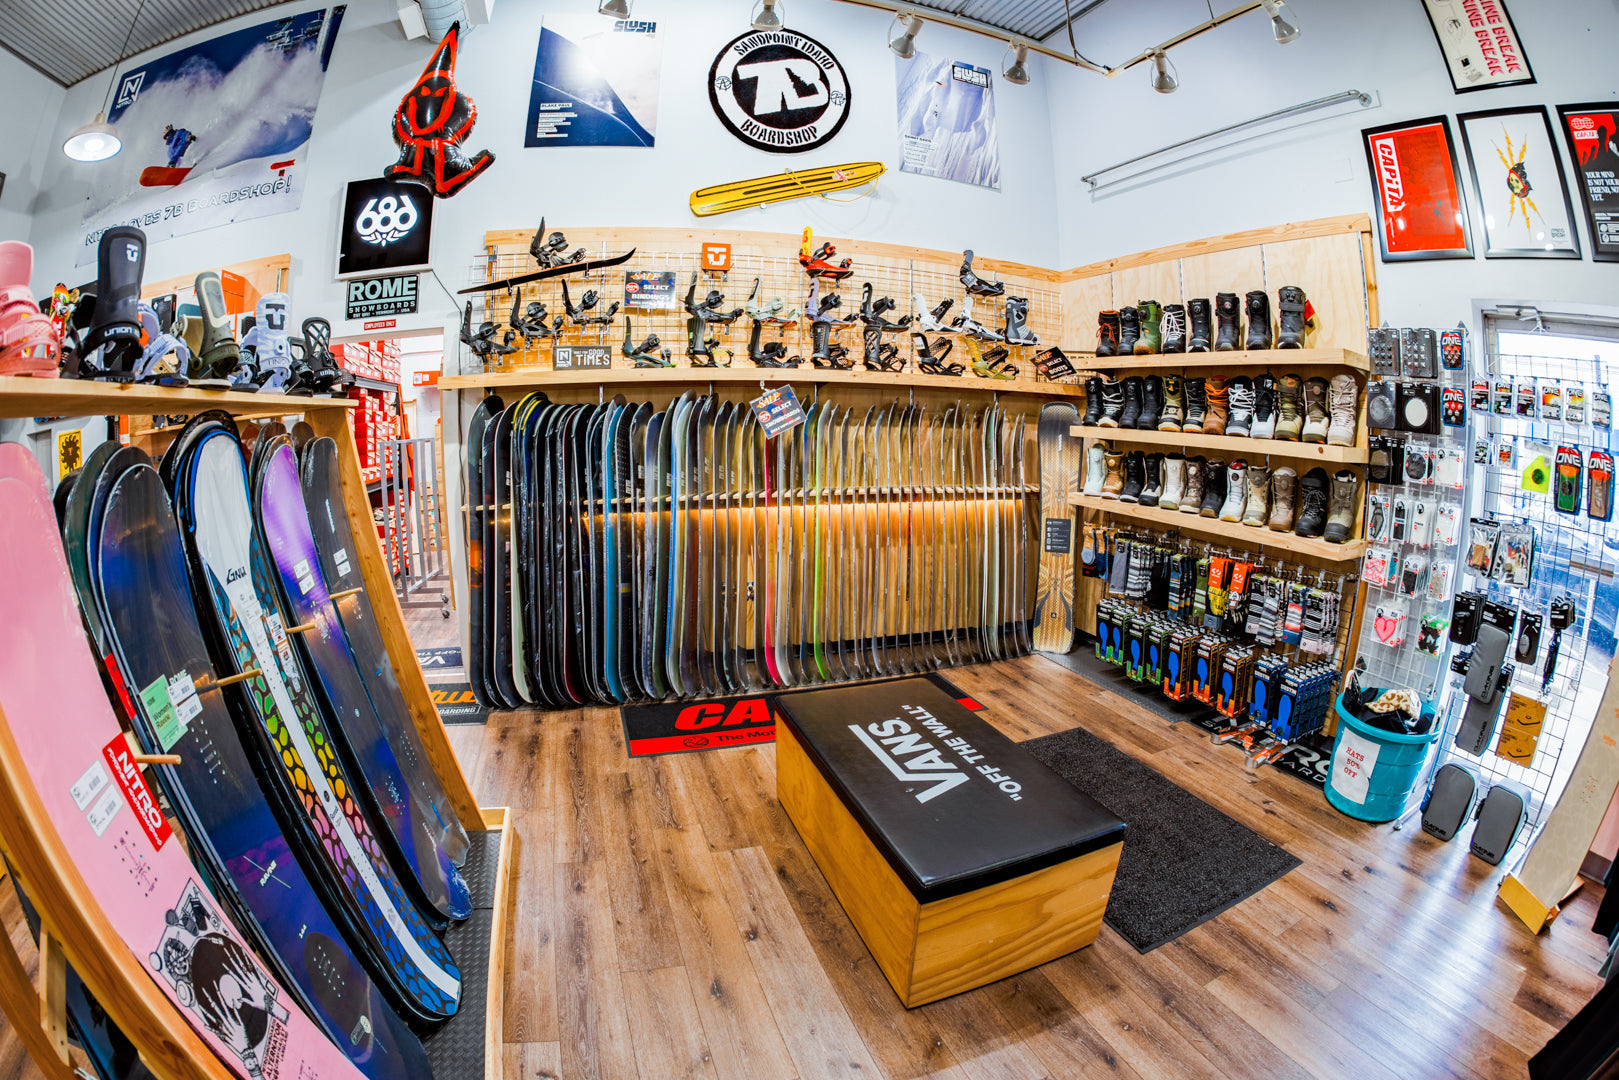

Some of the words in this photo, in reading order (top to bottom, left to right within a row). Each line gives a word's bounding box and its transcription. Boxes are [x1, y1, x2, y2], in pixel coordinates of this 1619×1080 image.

[614, 20, 656, 33] SLUSH
[1480, 0, 1502, 24] ING
[1492, 26, 1522, 73] BREAK
[733, 32, 802, 56] SANDPOINT
[801, 41, 835, 70] IDAHO
[1475, 29, 1504, 76] BREAK
[953, 66, 987, 86] SLUSH
[740, 119, 818, 146] BOARDSHOP
[187, 175, 292, 214] BOARDSHOP!
[356, 195, 418, 235] 686
[633, 272, 661, 280] SALE
[350, 276, 417, 302] ROME
[349, 301, 415, 314] SNOWBOARDS
[104, 326, 132, 337] union
[364, 321, 385, 329] EMPLOYEES
[1442, 336, 1462, 346] ONE
[576, 354, 610, 366] TIMES
[1047, 357, 1063, 367] SELECT
[1049, 364, 1069, 375] BOOTS
[1443, 393, 1465, 403] ONE
[1543, 387, 1560, 395] ONE
[1568, 389, 1583, 397] ONE
[1593, 394, 1608, 402] ONE
[771, 400, 792, 414] SELECT
[765, 408, 801, 429] SNOWBOARDS
[1556, 453, 1581, 468] ONE
[1588, 458, 1612, 473] ONE
[226, 566, 247, 585] GNU
[1481, 665, 1495, 698] DAKINE
[674, 699, 775, 730] CA
[901, 704, 953, 738] WALL"
[715, 734, 744, 742] The
[944, 737, 985, 764] THE
[1346, 746, 1365, 762] HATS
[848, 717, 970, 804] VANS
[1346, 758, 1361, 769] 50%
[1344, 766, 1358, 778] OFF
[117, 751, 162, 828] NITRO
[975, 764, 1023, 801] "OFF
[107, 747, 130, 787] FOREVER
[128, 787, 162, 846] SNOWBOARDING
[1424, 820, 1446, 836] DAKINE
[1473, 842, 1495, 858] DAKINE
[260, 860, 278, 886] RAVINE
[266, 1022, 282, 1079] ALTERNATOR
